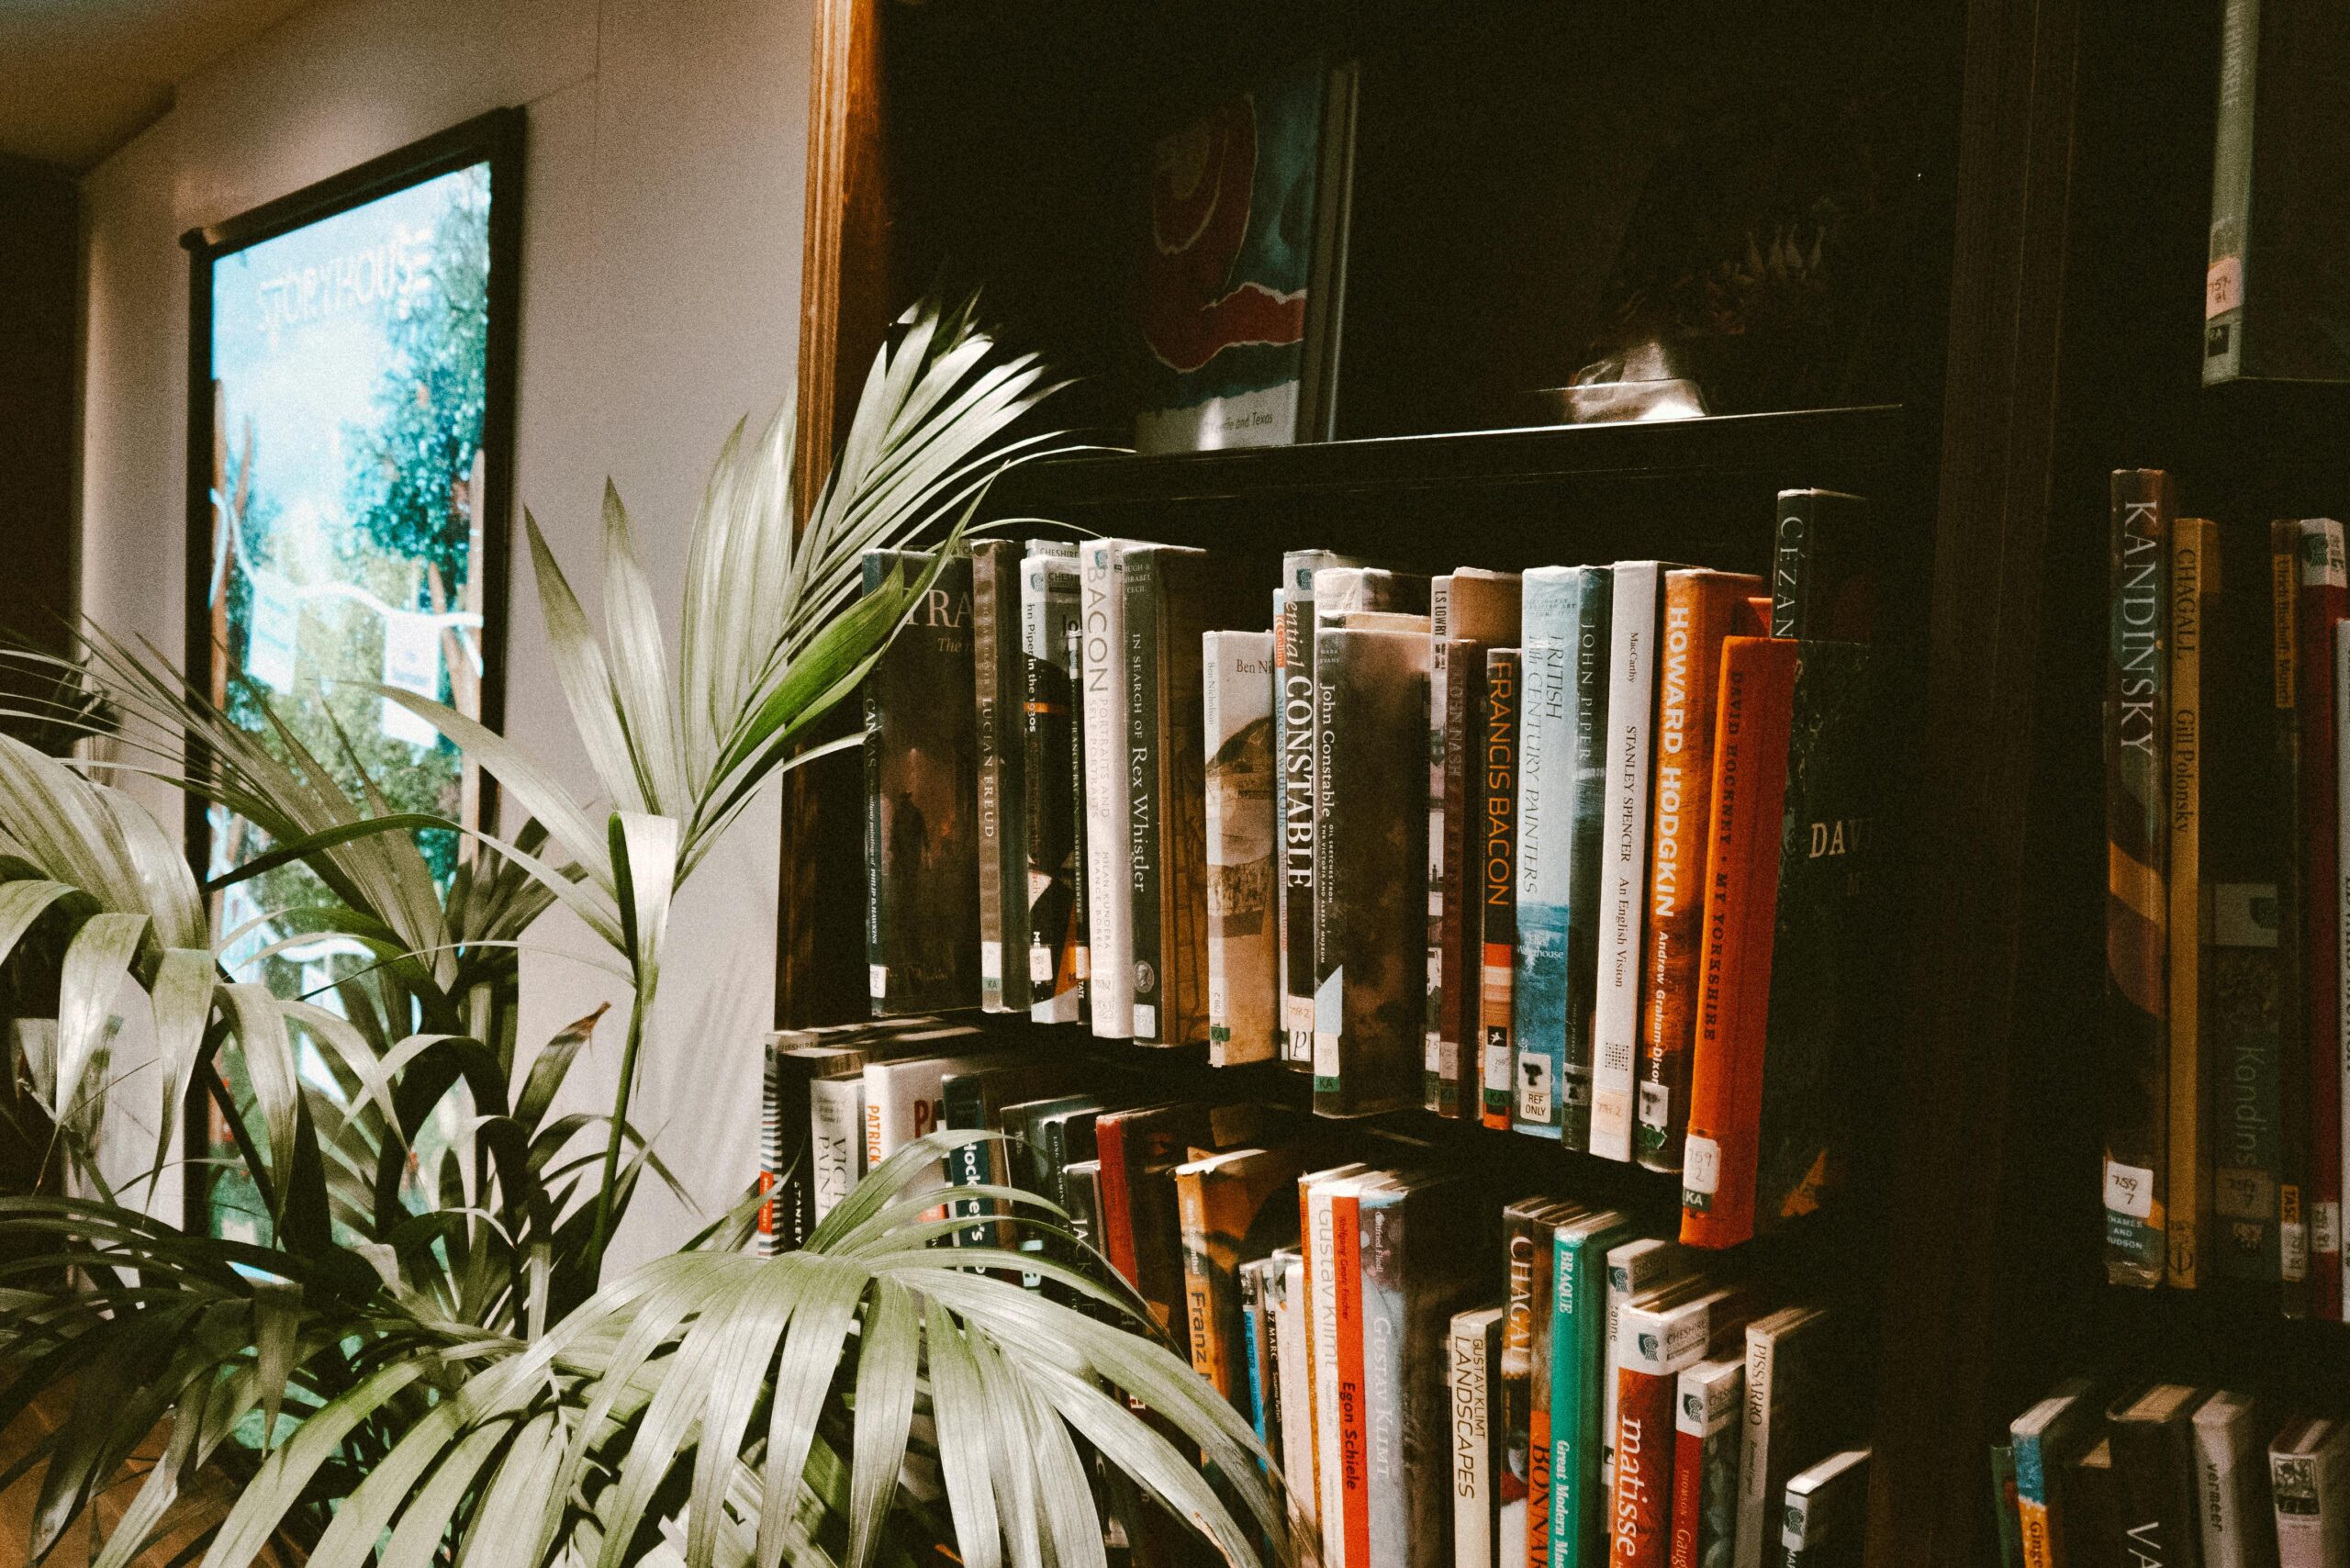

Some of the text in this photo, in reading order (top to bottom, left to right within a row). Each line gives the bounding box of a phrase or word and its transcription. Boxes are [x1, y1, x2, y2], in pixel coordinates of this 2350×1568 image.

[1252, 411, 1273, 426] Texas
[1774, 515, 1807, 639] CÉZAN
[1025, 624, 1035, 655] Piper
[1087, 566, 1110, 693] BACON
[1276, 627, 1285, 667] Collins
[1434, 606, 1448, 637] LOWRY
[2121, 499, 2158, 756] KANDINSKY
[1028, 658, 1037, 670] in
[1028, 673, 1038, 694] the
[1206, 661, 1216, 725] Ben Nicholson
[1237, 658, 1256, 674] Ben
[1546, 634, 1564, 721] BRITISH
[1578, 623, 1595, 762] JOHN PIPER
[2175, 548, 2196, 834] CHAGALL Gill Polonsky
[981, 698, 993, 767] LUCIAN
[1027, 697, 1037, 733] 1930s
[1276, 696, 1286, 753] Success
[1285, 601, 1314, 889] ential CONSTABLE
[1090, 737, 1099, 818] PORTRAITS
[1100, 697, 1110, 818] PORTRAITS AND
[1132, 633, 1149, 892] IN SEARCH OF Rex Whistler
[1319, 682, 1336, 818] John Constable
[983, 776, 995, 837] FREUD
[1487, 660, 1513, 906] FRANCIS BACON
[1523, 671, 1543, 894] CENTURY PAINTERS
[1614, 632, 1639, 989] MacCarthy STANLEY SPENCER An English Vision
[1071, 720, 1080, 771] FRANCIS
[1077, 980, 1085, 999] TATE
[1651, 606, 1690, 1086] HOWARD HODGKIN Andrew Graham-Dixon
[1703, 670, 1744, 1042] DAVID HOCKNEY MY YORKSHIRE
[1102, 851, 1113, 949] MILAN KUNDERA
[1319, 1078, 1334, 1090] KA
[1489, 1092, 1505, 1103] KA
[1525, 1104, 1546, 1117] ONLY
[1528, 1092, 1544, 1103] REF
[867, 1104, 882, 1164] PATRICK
[1688, 1148, 1713, 1166] 759
[1684, 1191, 1704, 1206] KA
[1695, 1164, 1706, 1182] 2
[2111, 1174, 2139, 1192] 759
[2124, 1193, 2135, 1204] 7
[793, 1182, 802, 1244] STANLEY
[2107, 1235, 2143, 1250] HUDSON
[2113, 1226, 2133, 1238] AND
[1318, 1208, 1334, 1298] Gustav
[1374, 1249, 1384, 1272] Fliedl
[1558, 1249, 1574, 1315] BRAQUE
[1191, 1292, 1207, 1363] Franz
[1341, 1288, 1350, 1320] Fischer
[1609, 1305, 1620, 1342] anne
[1268, 1326, 1279, 1360] MARC
[1322, 1305, 1338, 1367] Klimt
[1372, 1316, 1393, 1479] GUSTAV KLIMT
[1472, 1338, 1486, 1439] GUSTAV KLIMT
[1748, 1342, 1767, 1427] PISSARRO
[1339, 1381, 1360, 1490] Egon Schiele
[1454, 1336, 1475, 1499] LANDSCAPES
[1556, 1439, 1570, 1481] Great
[1617, 1414, 1649, 1557] matisse
[1555, 1481, 1570, 1537] Modern
[1679, 1468, 1690, 1517] THOMSON
[2207, 1462, 2224, 1531] vermeer
